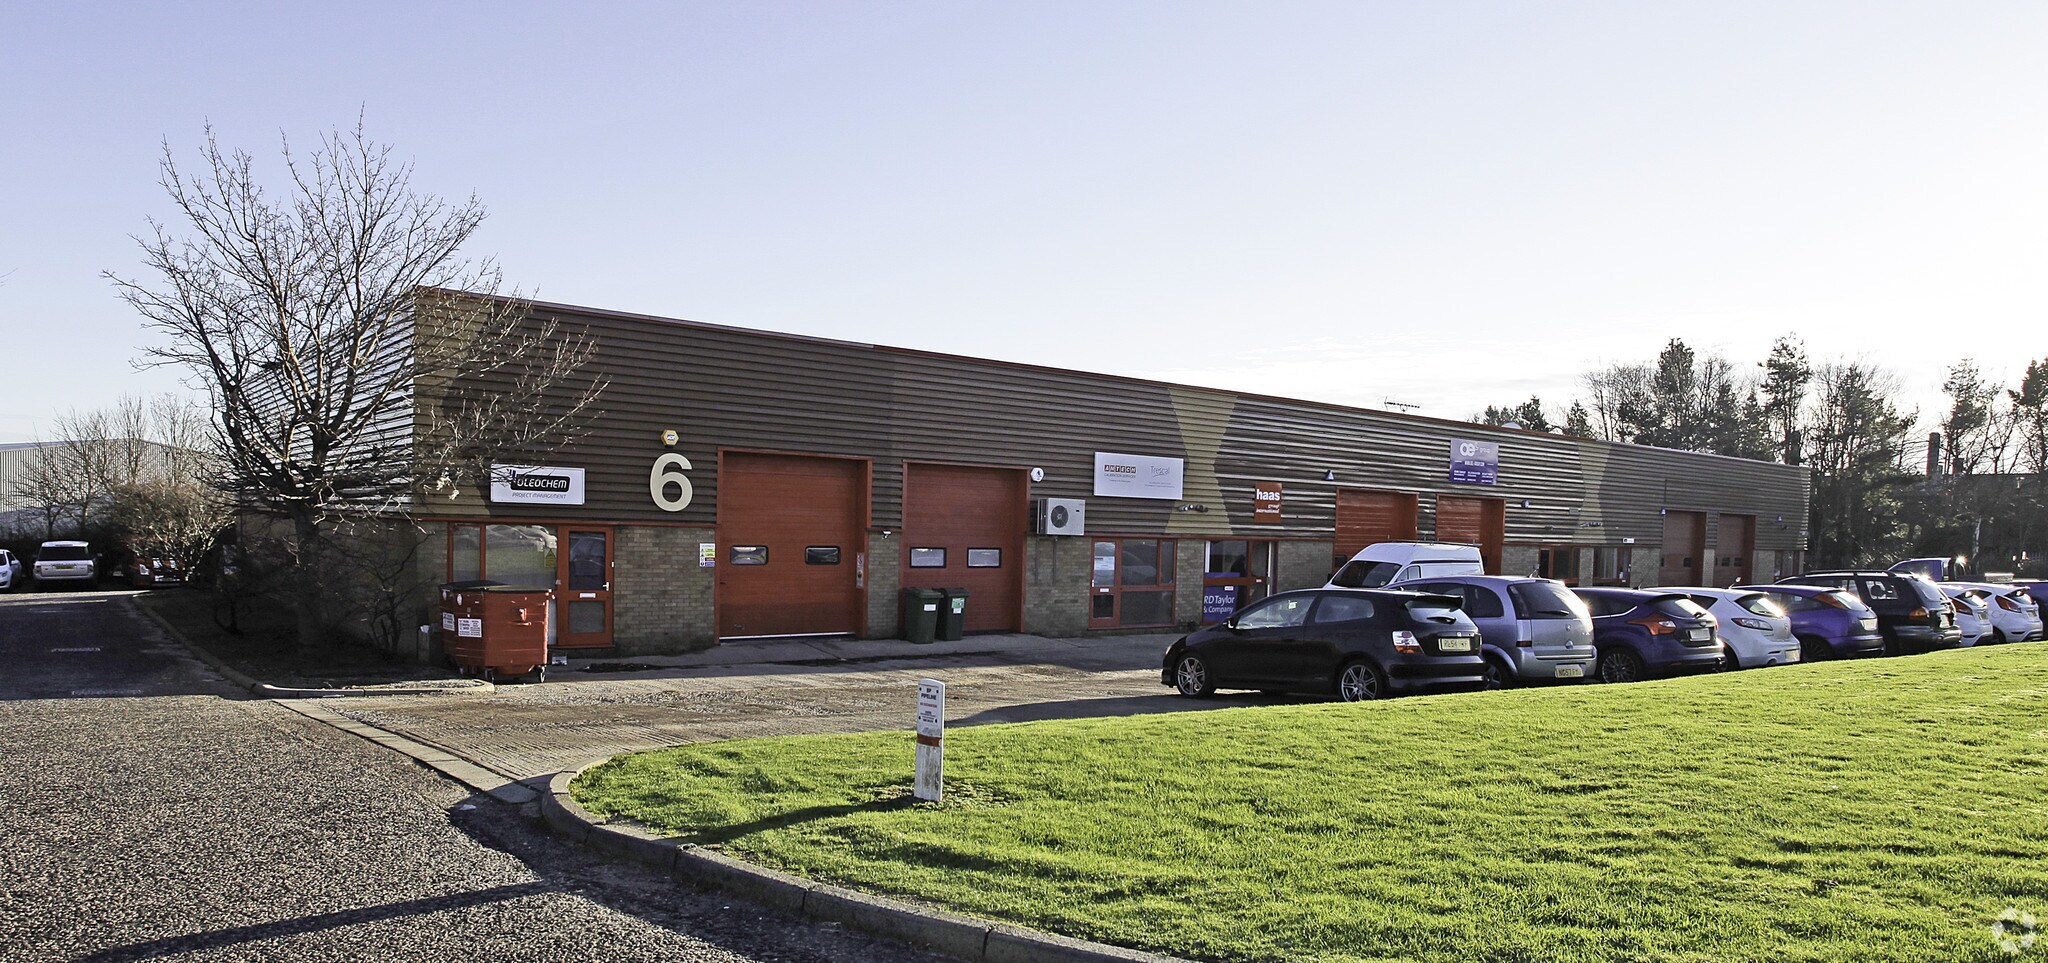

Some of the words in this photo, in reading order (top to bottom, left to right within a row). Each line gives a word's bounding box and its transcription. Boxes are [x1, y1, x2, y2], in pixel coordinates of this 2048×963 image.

[650, 452, 693, 512] 6
[1256, 488, 1280, 501] haas
[1203, 595, 1215, 605] RD
[1215, 595, 1235, 607] Taylor
[1208, 605, 1234, 615] Company
